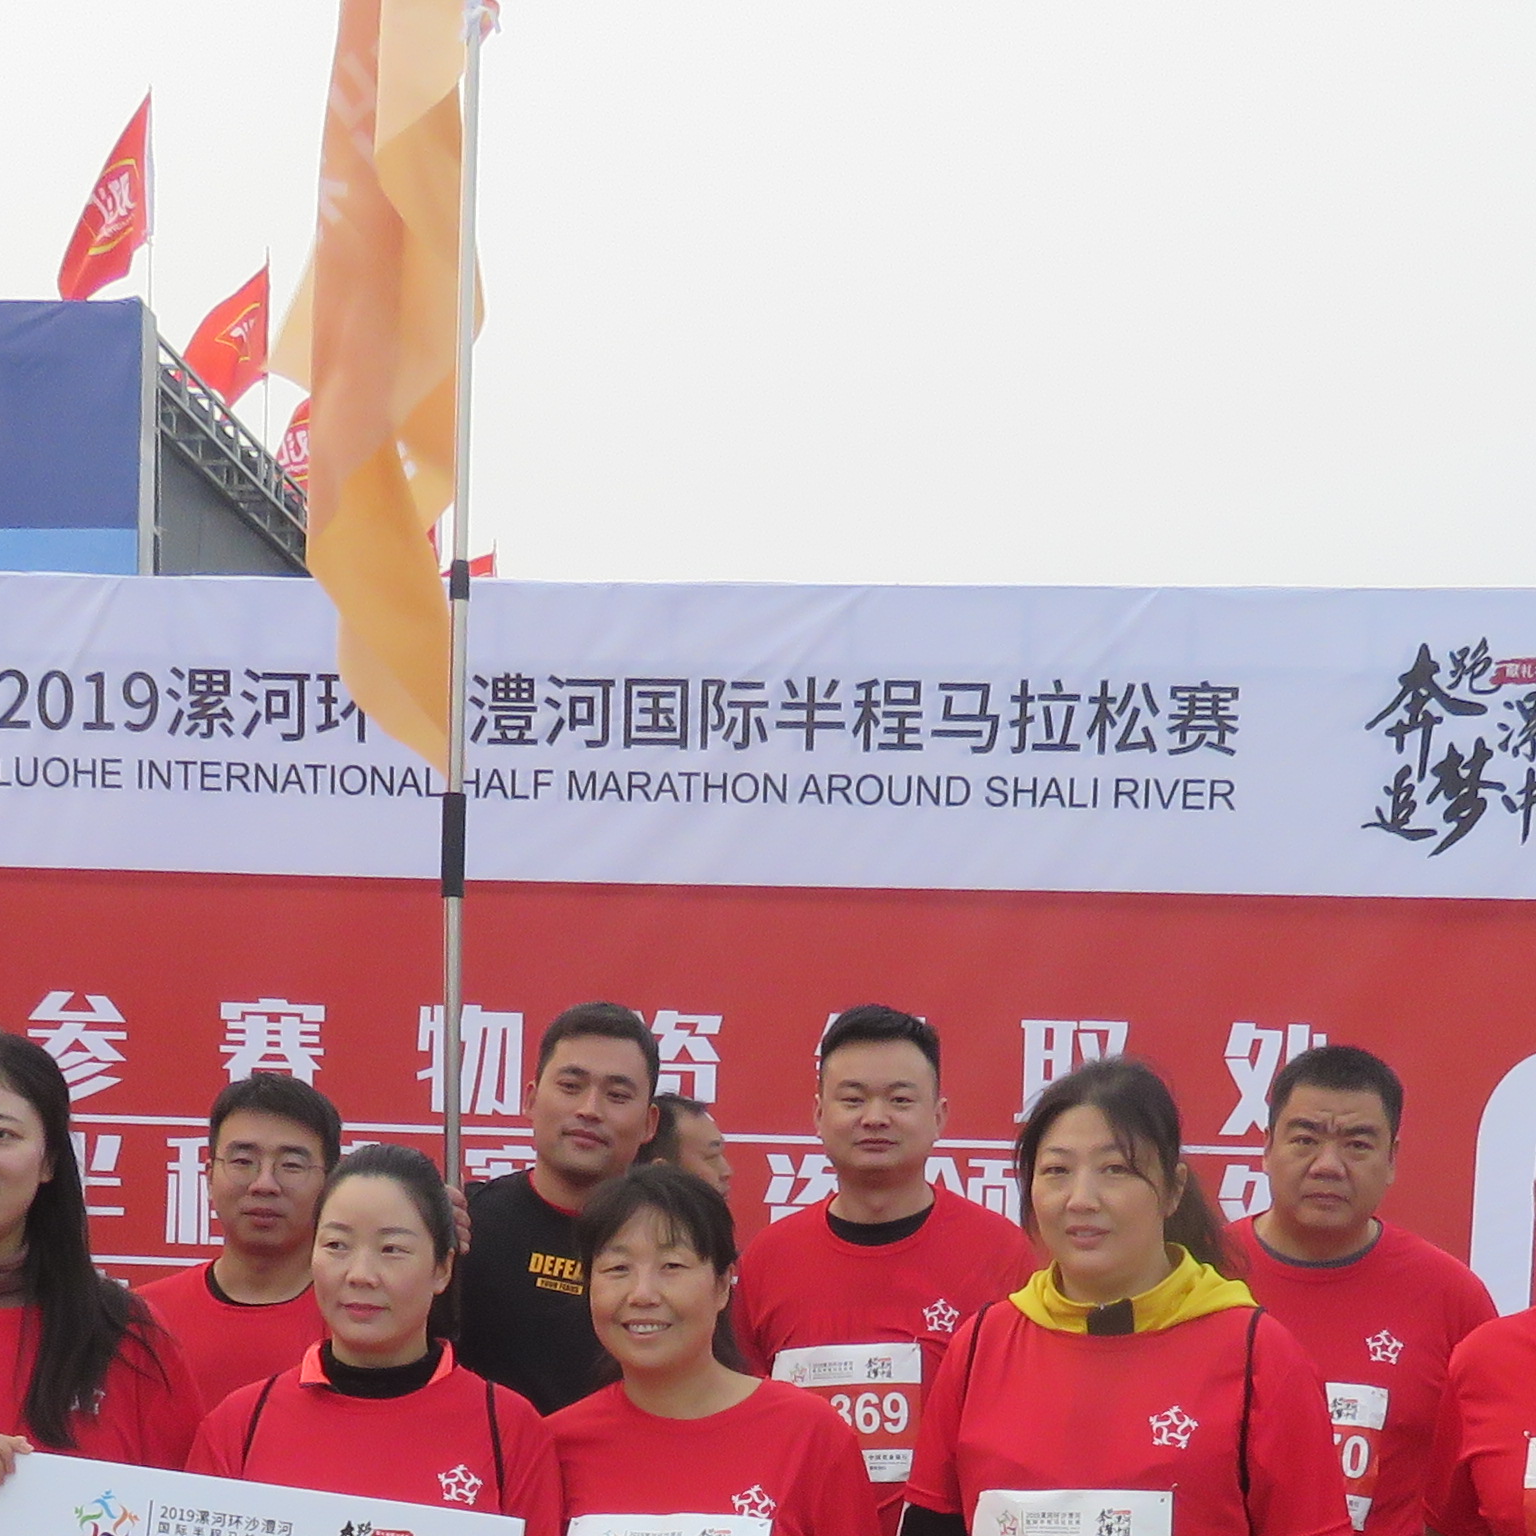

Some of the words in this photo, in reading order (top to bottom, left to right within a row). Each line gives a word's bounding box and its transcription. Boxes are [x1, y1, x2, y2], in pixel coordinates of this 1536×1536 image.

[136, 759, 444, 798] INTERNATIONAL
[567, 769, 788, 805] MARATHON
[797, 772, 970, 808] AROUND
[983, 774, 1101, 810] SHALI
[1113, 777, 1237, 812] RIVER
[160, 1505, 294, 1536] 2019漯河环沙澧河
